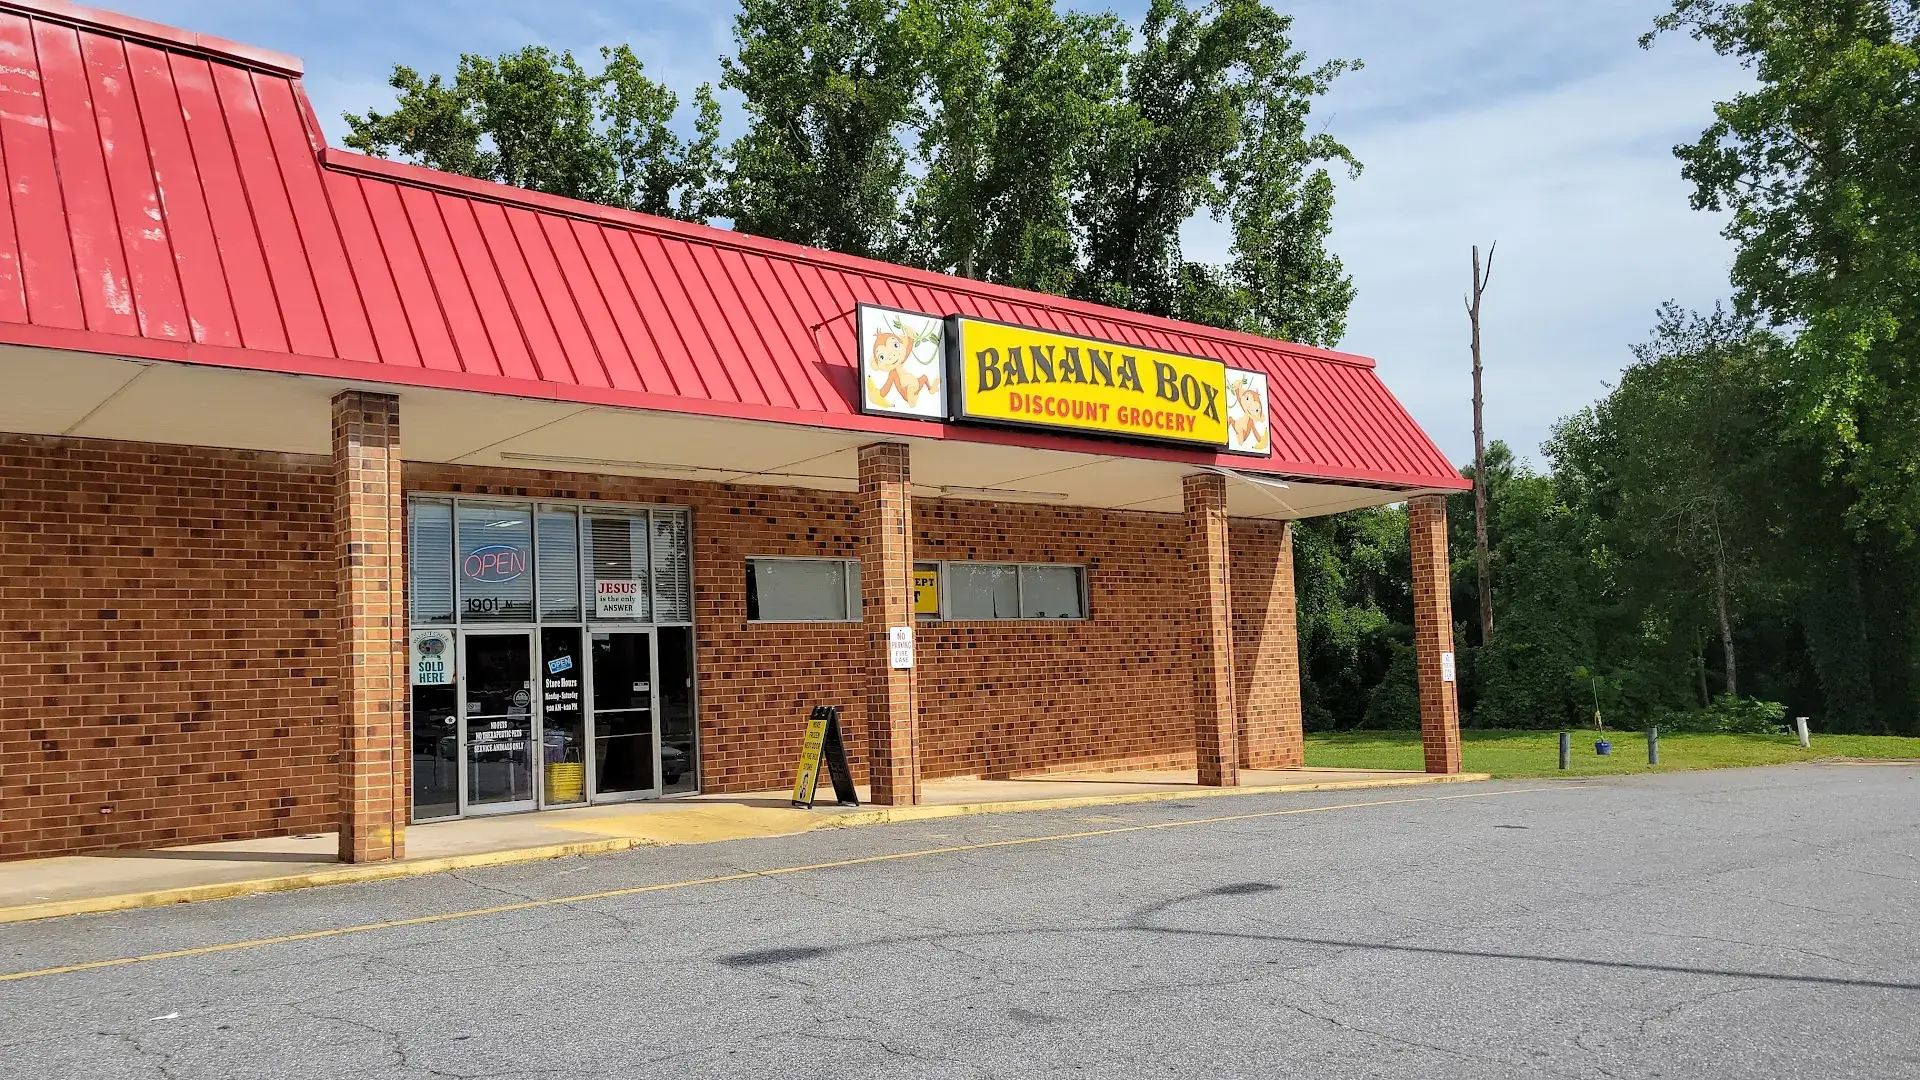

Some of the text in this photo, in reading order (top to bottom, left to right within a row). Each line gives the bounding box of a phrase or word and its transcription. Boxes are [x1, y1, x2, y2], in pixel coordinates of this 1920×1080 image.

[975, 345, 1220, 424] BANANA BOX
[1009, 391, 1197, 433] DISCOUNT GROCERY
[464, 550, 526, 577] OPEN
[597, 582, 637, 594] JESUS
[914, 578, 935, 587] EPT
[465, 597, 499, 612] 1901
[620, 595, 636, 604] only
[603, 604, 634, 612] ANSWER
[897, 632, 906, 641] NO
[891, 641, 912, 650] PARKING
[418, 661, 444, 672] SOLD
[550, 658, 570, 669] OPEN
[419, 672, 445, 683] HERE
[545, 677, 578, 688] Store Hours
[490, 721, 508, 730] NO PETS
[475, 729, 523, 740] NO THERAPEUTIC PETS
[474, 742, 525, 753] SERVICE ANIMALS ONLY
